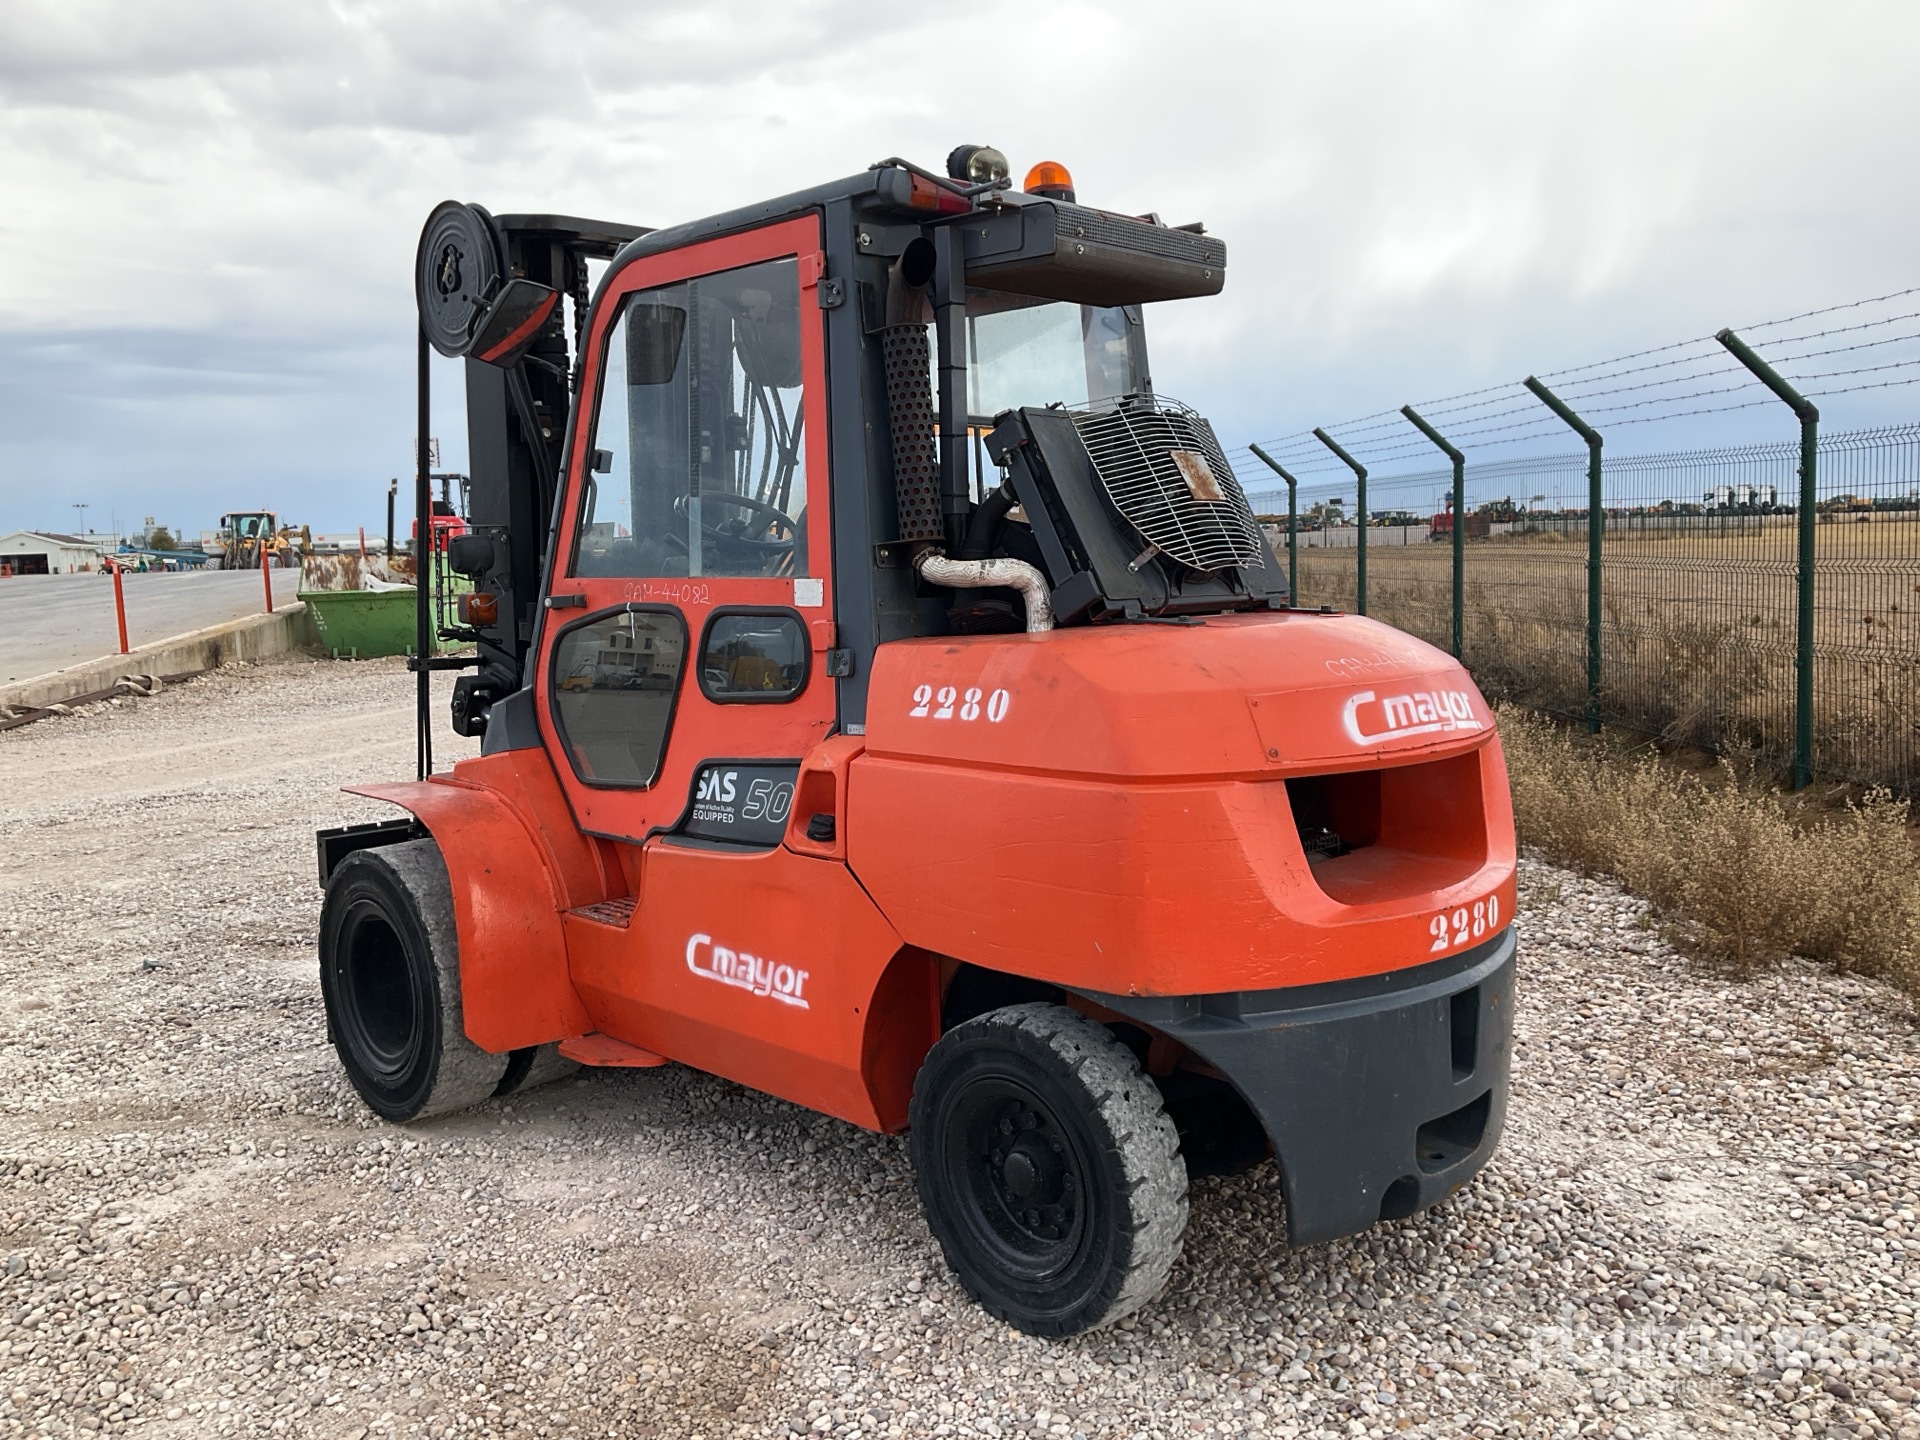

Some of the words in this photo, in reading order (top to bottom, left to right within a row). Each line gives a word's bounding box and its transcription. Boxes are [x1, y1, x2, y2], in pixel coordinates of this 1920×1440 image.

[624, 582, 711, 605] GAM-44082
[909, 684, 1010, 723] 2280
[696, 769, 738, 803] SAS
[742, 778, 795, 824] 50
[693, 809, 734, 824] EQUIPPED
[1429, 894, 1499, 953] 2280
